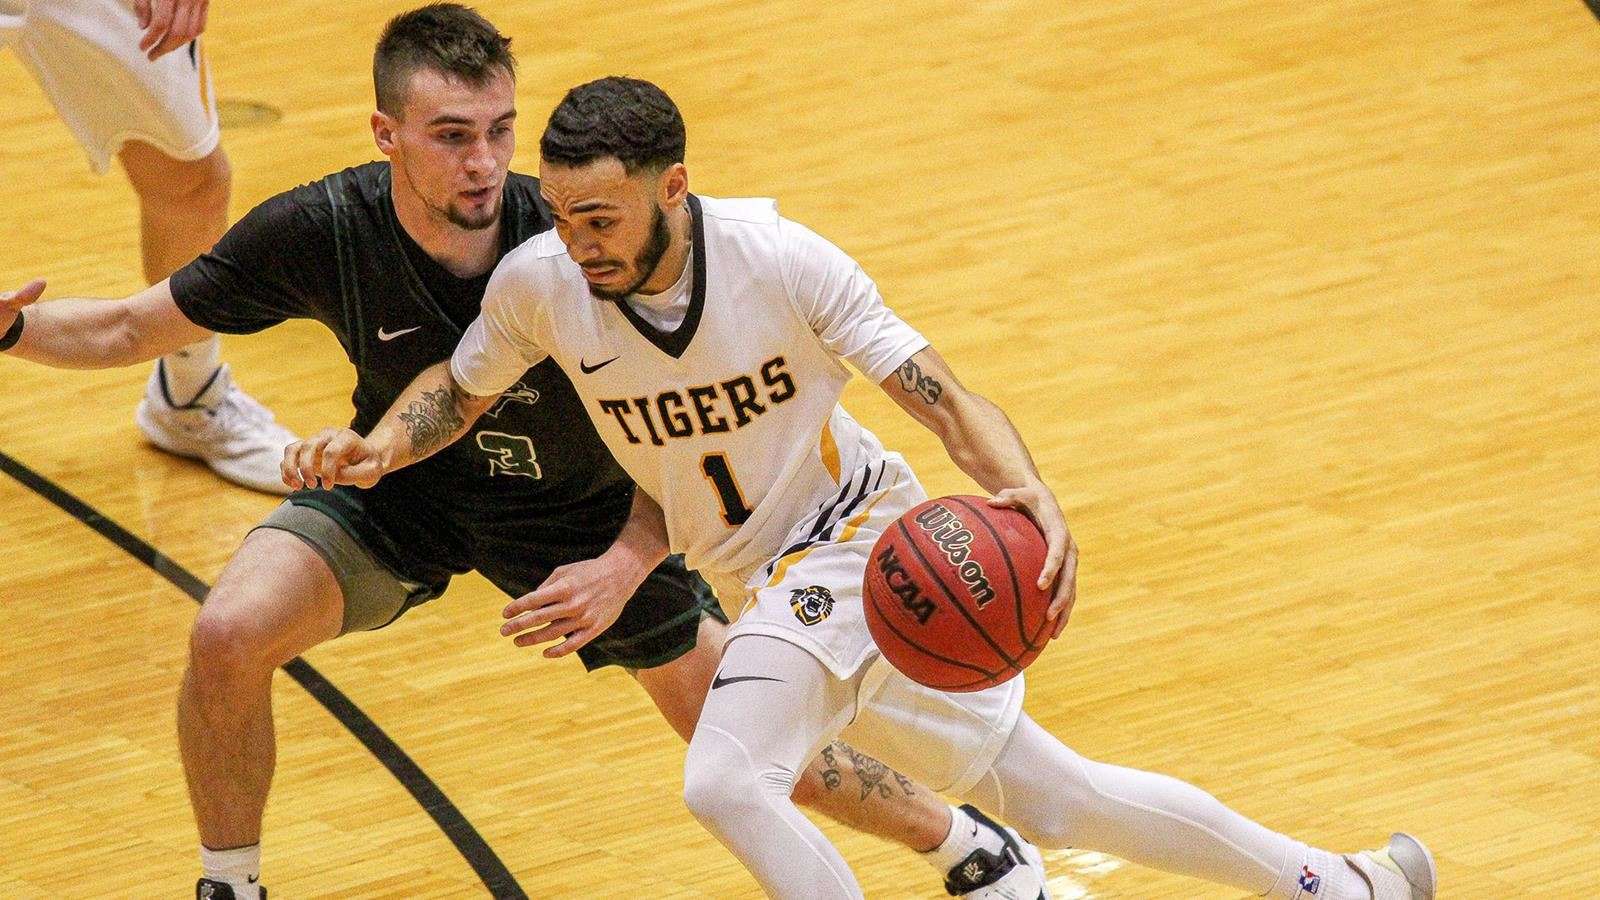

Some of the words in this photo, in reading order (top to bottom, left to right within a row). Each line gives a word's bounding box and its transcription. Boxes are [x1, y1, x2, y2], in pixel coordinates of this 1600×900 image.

[598, 356, 797, 447] TIGERS
[476, 430, 542, 480] 3
[700, 451, 755, 528] 1
[876, 543, 939, 626] NCAA
[914, 503, 997, 611] Wilson
